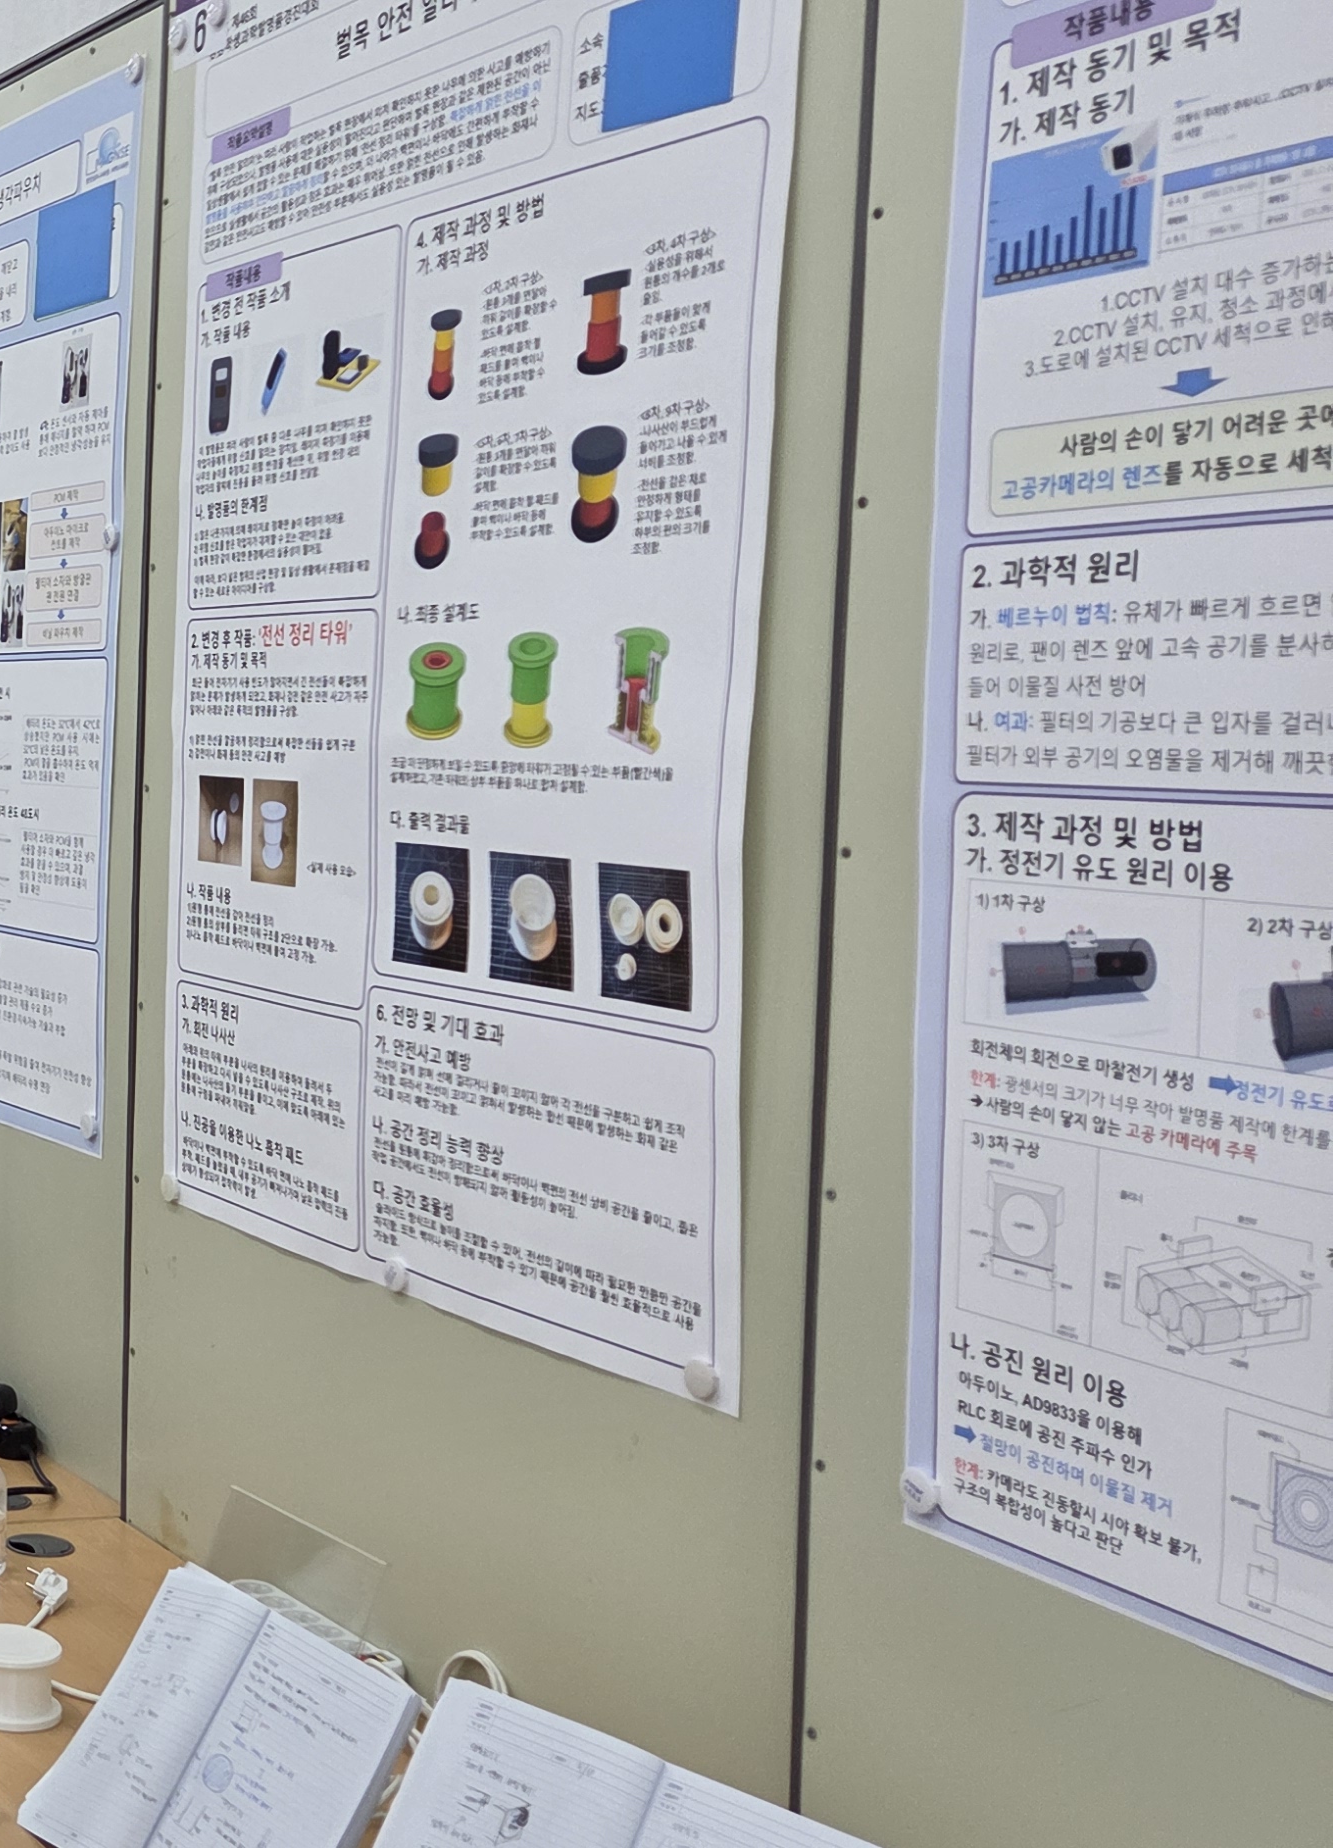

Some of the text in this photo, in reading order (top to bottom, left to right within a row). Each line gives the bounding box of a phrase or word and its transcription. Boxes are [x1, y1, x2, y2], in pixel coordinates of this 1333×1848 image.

[193, 9, 208, 53] 6
[336, 20, 370, 60] 벌목
[378, 2, 413, 42] 안전
[1000, 9, 1242, 107] 1. 제작 동기 및 목적
[1000, 85, 1135, 145] 가. 제작 동기
[415, 193, 544, 248] 4. 제작 과정 및 방법
[202, 309, 208, 323] 1.
[234, 297, 243, 315] 전
[247, 288, 266, 310] 작품
[269, 280, 290, 304] 소개
[1102, 284, 1165, 313] 1.CCTV
[1171, 273, 1206, 303] 설치
[1214, 264, 1254, 296] 대수
[1025, 317, 1292, 378] 3.도로에 설치된 CCTV 세척으로
[1055, 320, 1116, 347] 2.CCTV
[1122, 312, 1163, 339] 설치,
[1061, 408, 1285, 456] 사람의 손이 닿기 어려운
[1002, 466, 1113, 499] 고공카메라의
[1122, 462, 1184, 491] 렌즈를
[1191, 453, 1277, 480] 자동으로
[972, 549, 1140, 589] 2. 과학적 원리
[970, 593, 1321, 629] 가. 베르누이 법칙: 유체가 빠르게 흐르면
[192, 634, 199, 648] 2.
[202, 630, 219, 649] 변경
[222, 630, 230, 648] 후
[234, 629, 256, 648] 작품:
[290, 622, 314, 646] 정리
[968, 713, 987, 732] 나.
[994, 711, 1033, 732] 여과:
[1039, 711, 1093, 734] 필터의
[1100, 711, 1176, 734] 기공보다
[1183, 711, 1202, 734] 큰
[1211, 711, 1273, 735] 입자를
[967, 812, 1205, 852] 3. 제작 과정 및 방법
[965, 849, 1234, 892] 가. 정전기 유도 원리 이용
[375, 1036, 388, 1054] 가.
[377, 1005, 504, 1046] 6. 전망 및 기대 효과
[971, 1038, 1194, 1092] 회전체의 회전으로 마찰전기 생성
[372, 1116, 387, 1134] 나.
[391, 1120, 413, 1141] 공간
[416, 1125, 441, 1150] 정리
[986, 1097, 1258, 1163] 사람의 손이 닿지 않는 고공 카메라에 주목
[951, 1332, 1127, 1408] 나. 공진 원리 이용
[959, 1370, 1142, 1446] 아두이노, AD9833을 이용해
[958, 1400, 1152, 1479] RLC 회로에 공진 주파수 인가
[1026, 1450, 1084, 1486] 공진하며
[1090, 1473, 1135, 1504] 이물질
[1140, 1490, 1173, 1518] 제거
[954, 1456, 1202, 1564] 한계: 카메라도 진동할시 시야 확보 불가,
[954, 1478, 1123, 1556] 구조의 복합성이 높다고 판단
